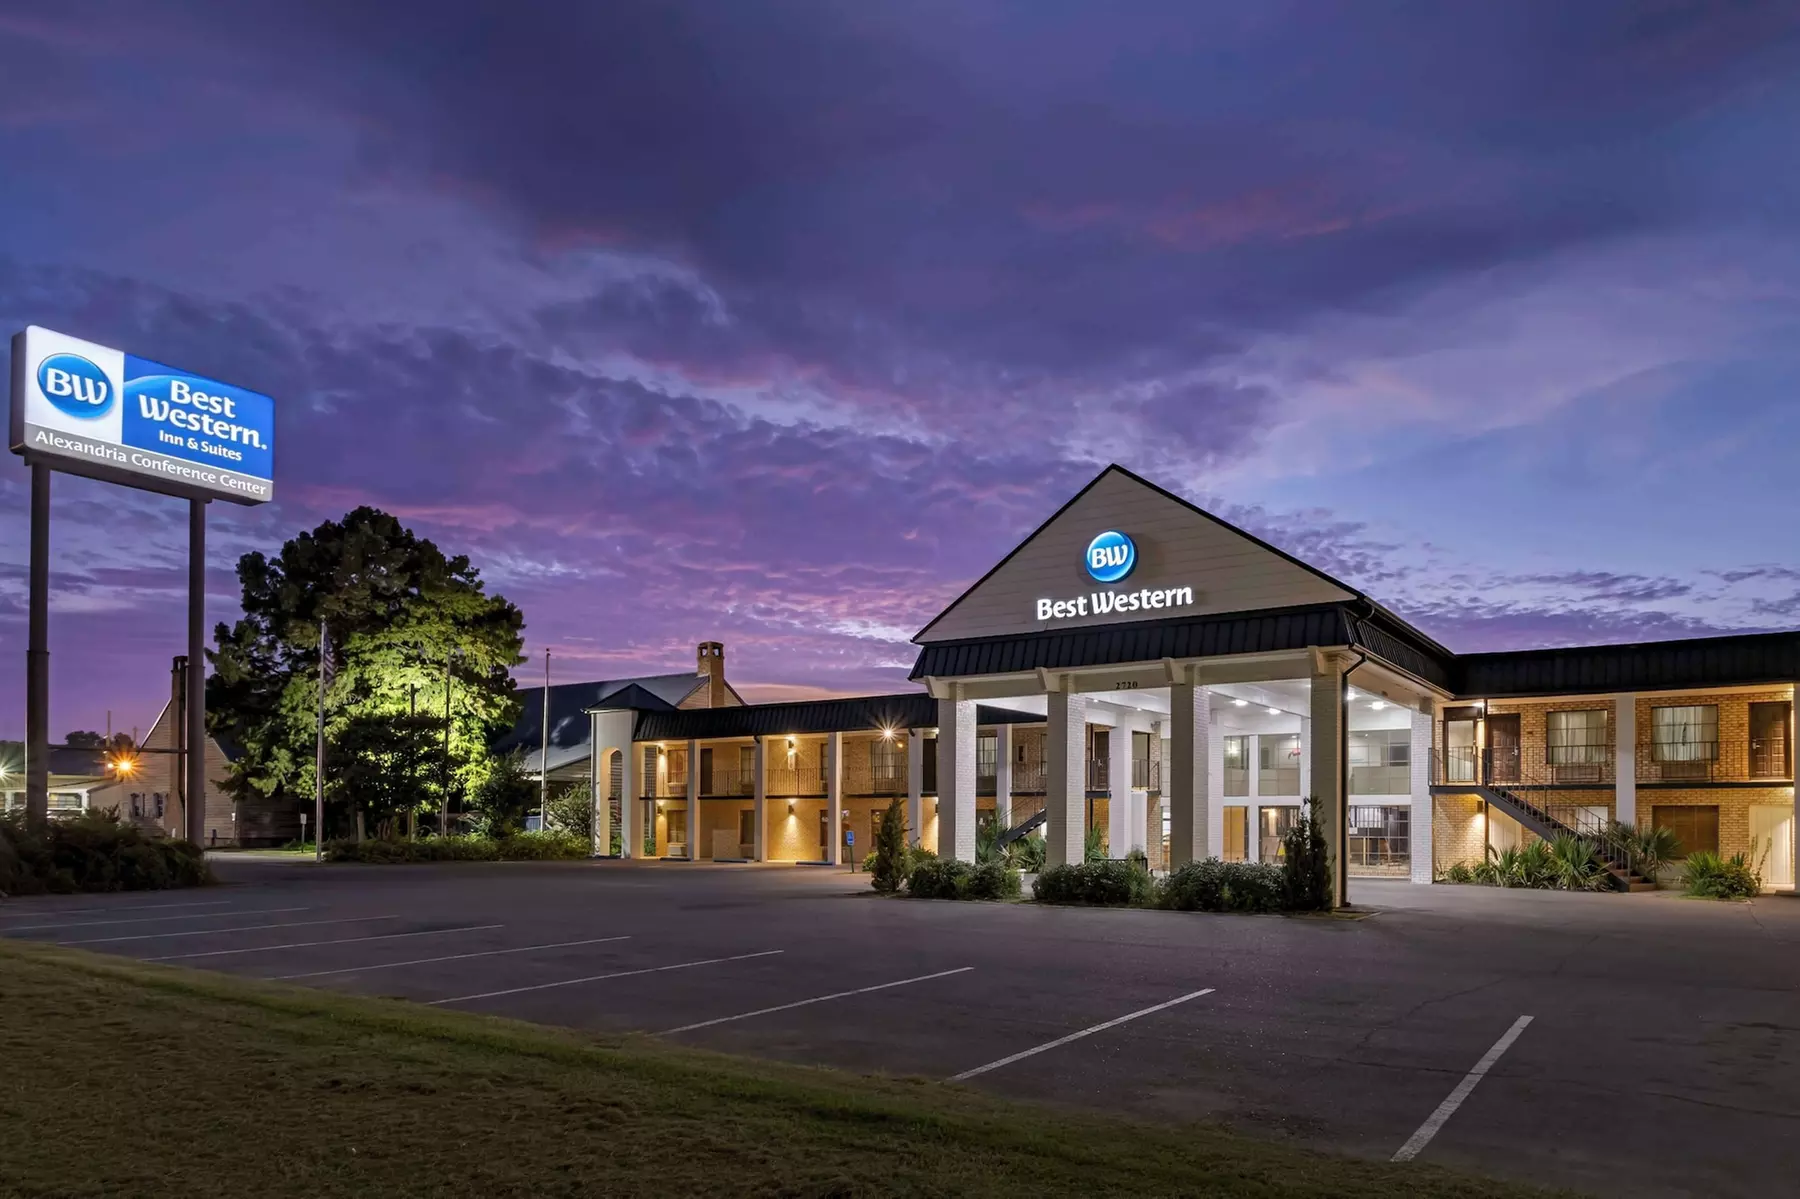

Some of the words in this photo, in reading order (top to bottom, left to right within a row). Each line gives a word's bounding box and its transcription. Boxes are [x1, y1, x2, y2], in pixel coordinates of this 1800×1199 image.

[47, 367, 107, 404] BW
[170, 379, 236, 418] Best
[158, 430, 184, 446] Inn
[187, 437, 199, 450] &
[201, 441, 243, 461] Suites
[35, 430, 127, 463] Alexandria
[131, 452, 216, 484] Conference
[219, 474, 266, 496] Center
[1091, 544, 1128, 568] BW
[1037, 595, 1088, 620] Best
[1091, 586, 1193, 614] Western
[1115, 681, 1138, 690] 2720
